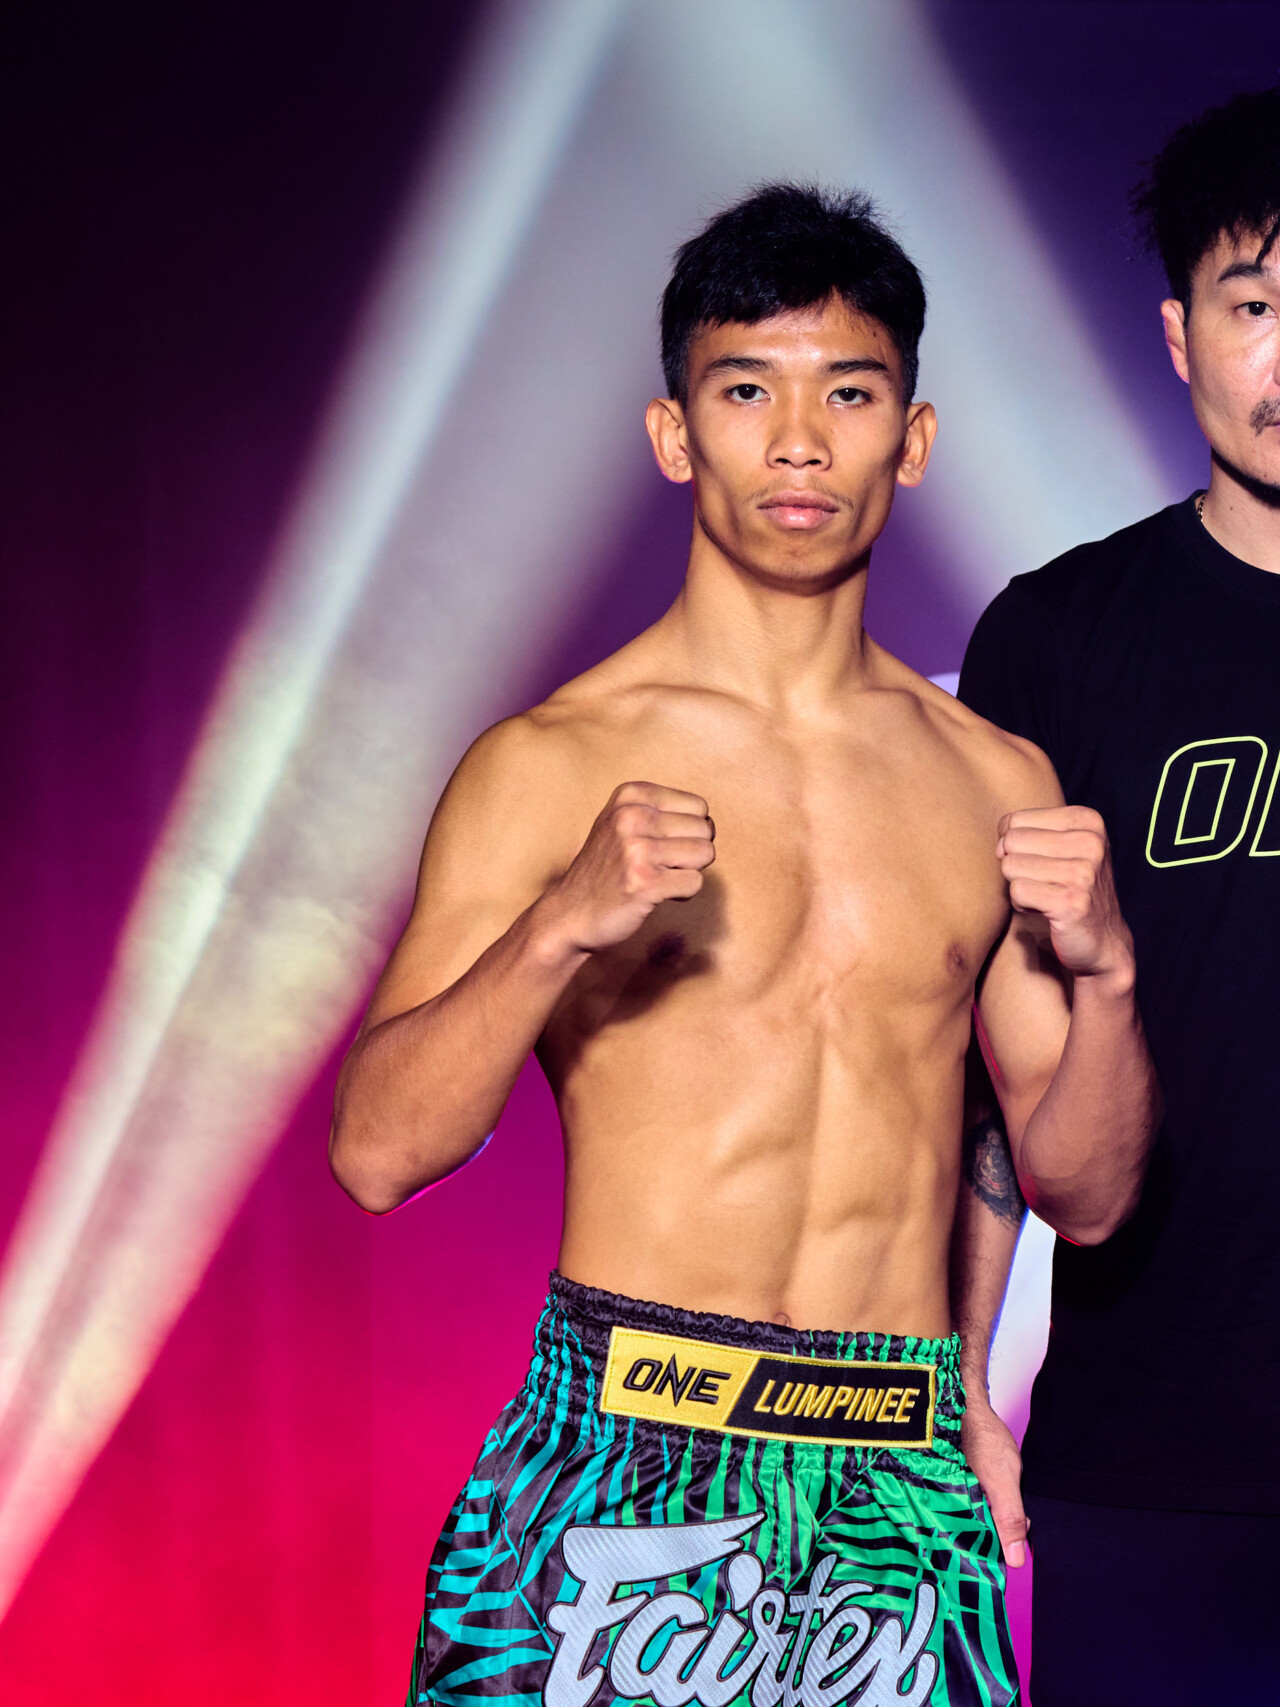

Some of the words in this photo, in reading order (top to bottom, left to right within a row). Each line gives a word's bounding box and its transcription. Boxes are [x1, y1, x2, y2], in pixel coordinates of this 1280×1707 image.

[622, 1352, 732, 1407] ONE
[753, 1379, 921, 1423] LUMPINEE
[542, 1511, 939, 1707] Fairtex
